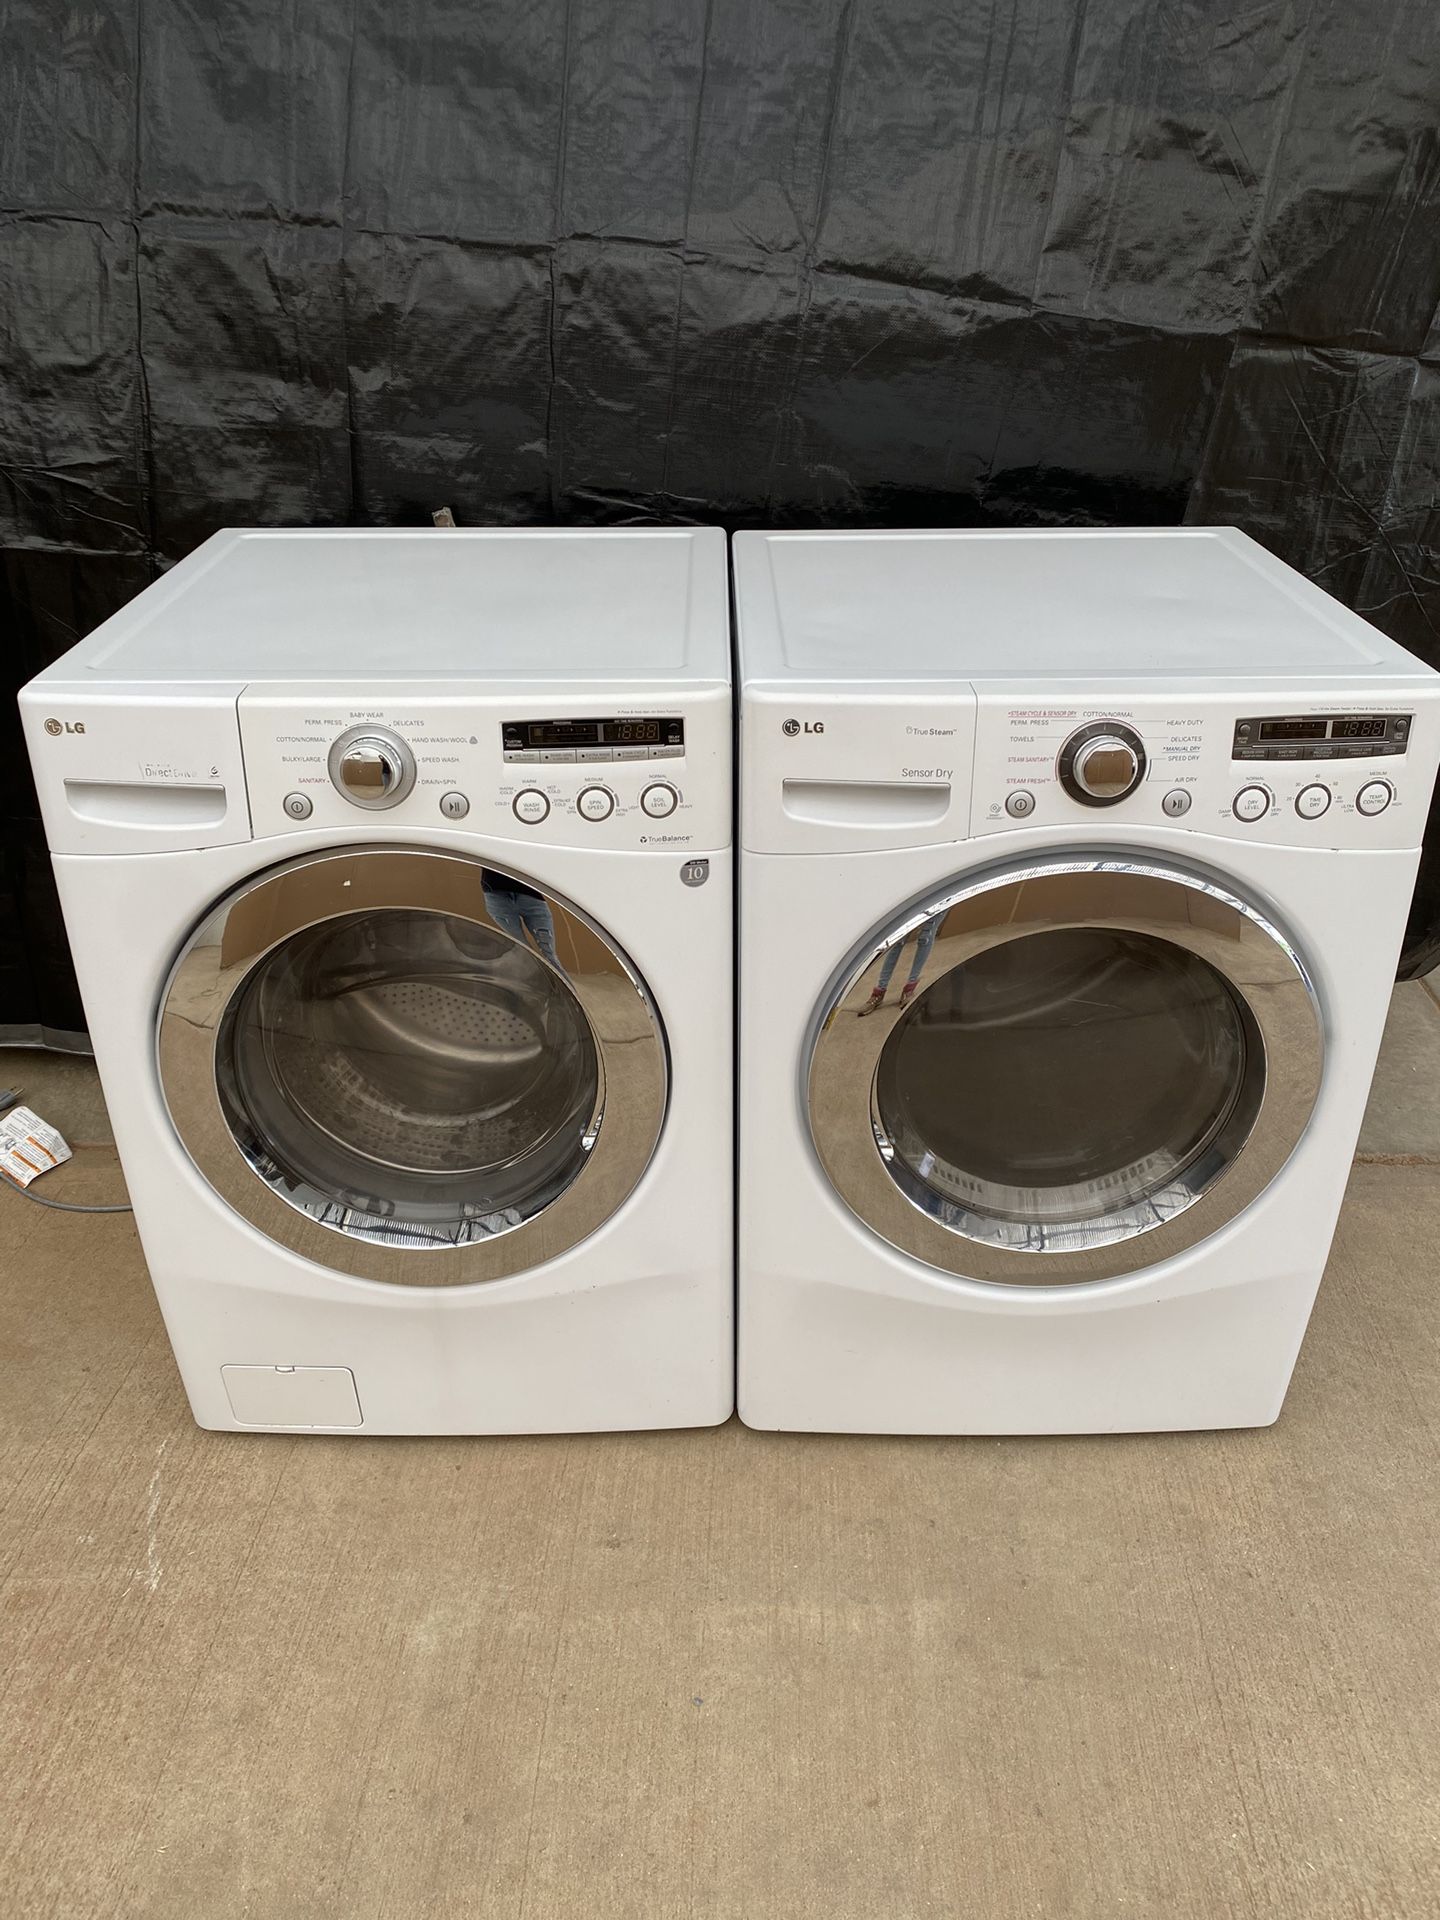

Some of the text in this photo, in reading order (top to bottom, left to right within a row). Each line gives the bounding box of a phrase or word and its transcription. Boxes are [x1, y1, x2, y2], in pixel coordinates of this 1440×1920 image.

[65, 722, 85, 734] LG
[804, 722, 824, 734] LG
[901, 768, 953, 780] Sensor Dry
[688, 866, 703, 880] 10
